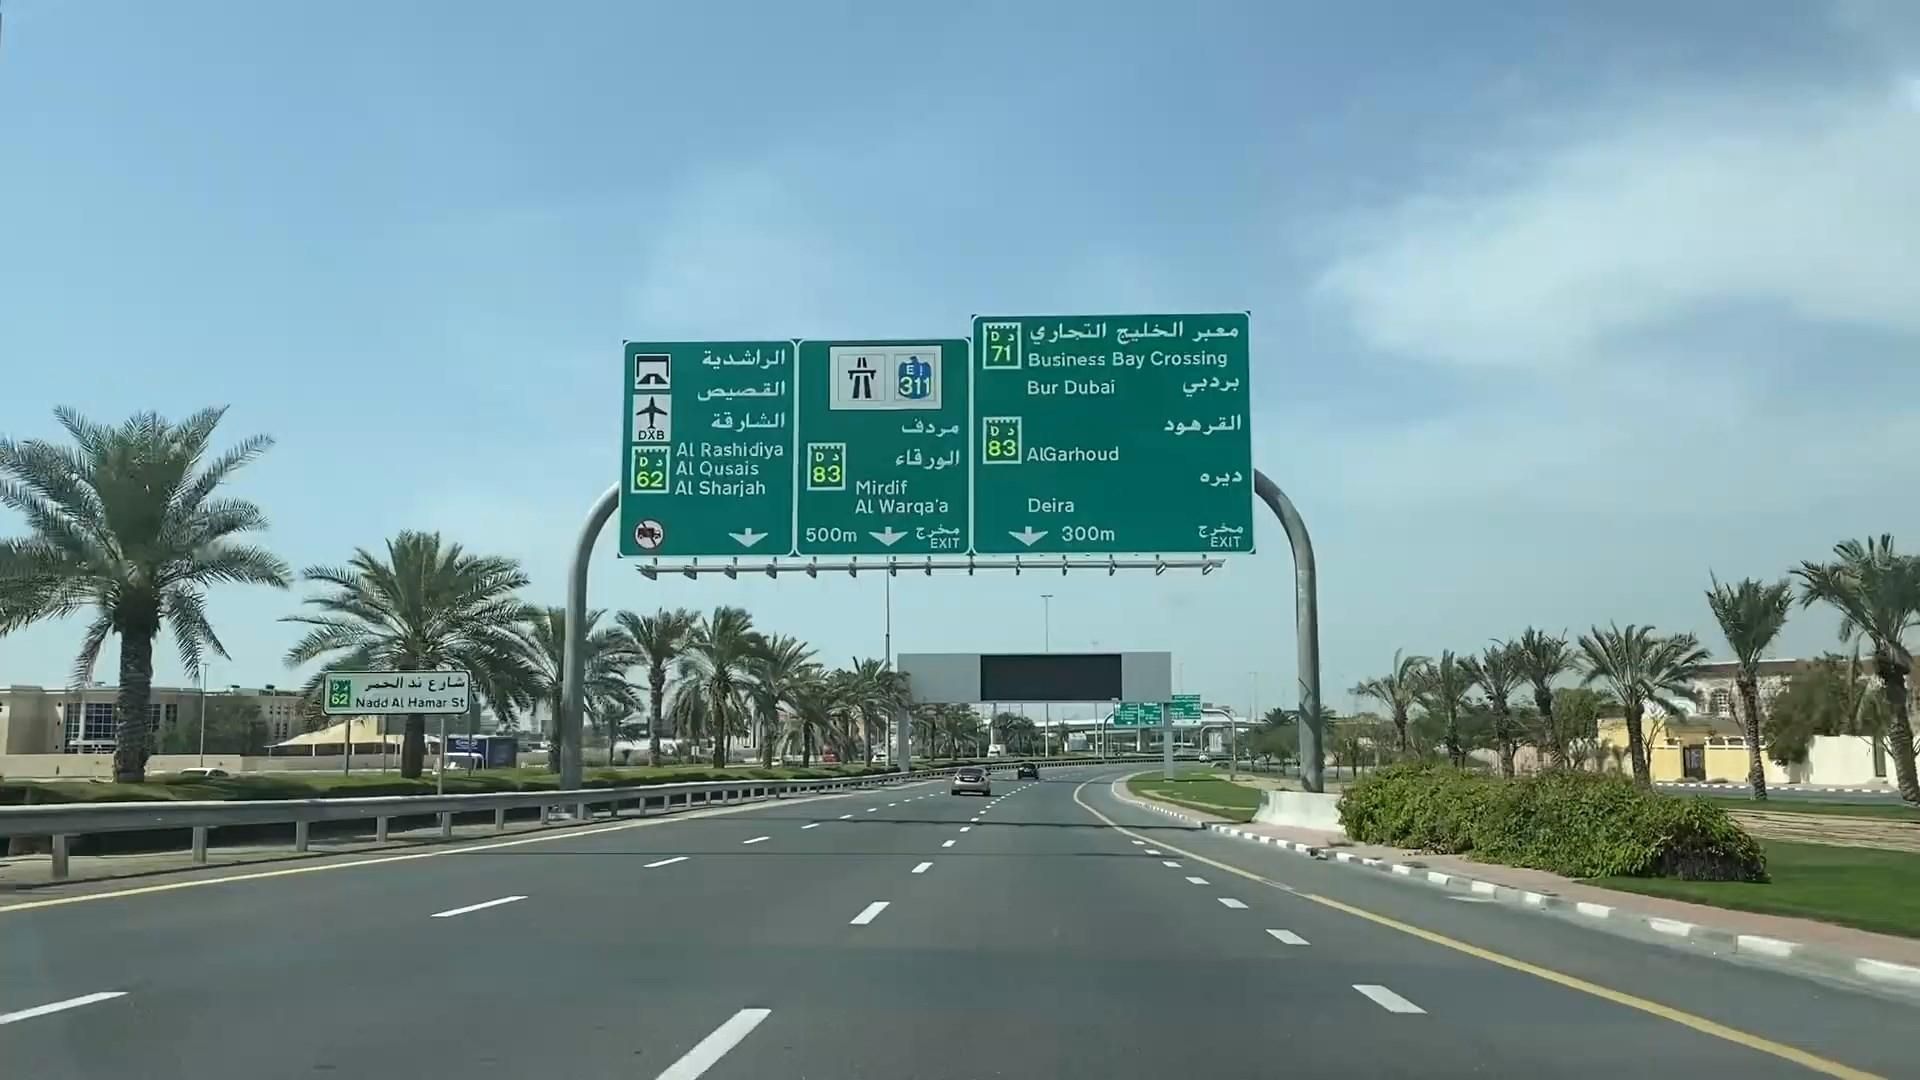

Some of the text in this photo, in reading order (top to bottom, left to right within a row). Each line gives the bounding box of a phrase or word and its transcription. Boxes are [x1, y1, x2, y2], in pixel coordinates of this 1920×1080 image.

[991, 332, 999, 341] D
[1030, 321, 1239, 345] معبر الخليج التجاري
[702, 349, 785, 369] الراشدية
[991, 345, 1012, 362] 71
[1028, 351, 1228, 369] Business Bay Crossing
[906, 365, 914, 375] E
[697, 381, 785, 401] القصيص
[899, 377, 930, 395] 311
[1028, 379, 1115, 395] Bur Dubai
[711, 412, 785, 432] الشارقة
[901, 418, 959, 437] مردف
[1164, 415, 1241, 435] القرهود
[638, 431, 665, 440] DXB
[990, 426, 1000, 436] D
[676, 442, 784, 459] Al Rashidiya
[988, 440, 1016, 457] 83
[1027, 446, 1119, 462] AlGarhoud
[639, 457, 648, 466] D
[816, 452, 824, 462] D
[896, 449, 960, 469] الورقاء
[676, 461, 759, 476] Al Qusais
[813, 466, 841, 482] 83
[636, 472, 664, 487] 62
[1200, 470, 1242, 486] ديره
[675, 480, 766, 497] Al Sharjah
[856, 480, 908, 495] Mirdif
[855, 499, 948, 515] Al Warqa'a
[1028, 498, 1074, 513] Deira
[806, 528, 857, 542] 500m
[915, 524, 960, 540] مخرج
[1062, 526, 1115, 542] 300m
[1198, 523, 1243, 538] مخرج
[930, 538, 960, 549] EXIT
[1210, 536, 1241, 548] EXIT
[365, 676, 465, 692] شارع ند الحمر
[331, 694, 347, 704] 62
[356, 697, 464, 708] Nadd Al Hamar St
